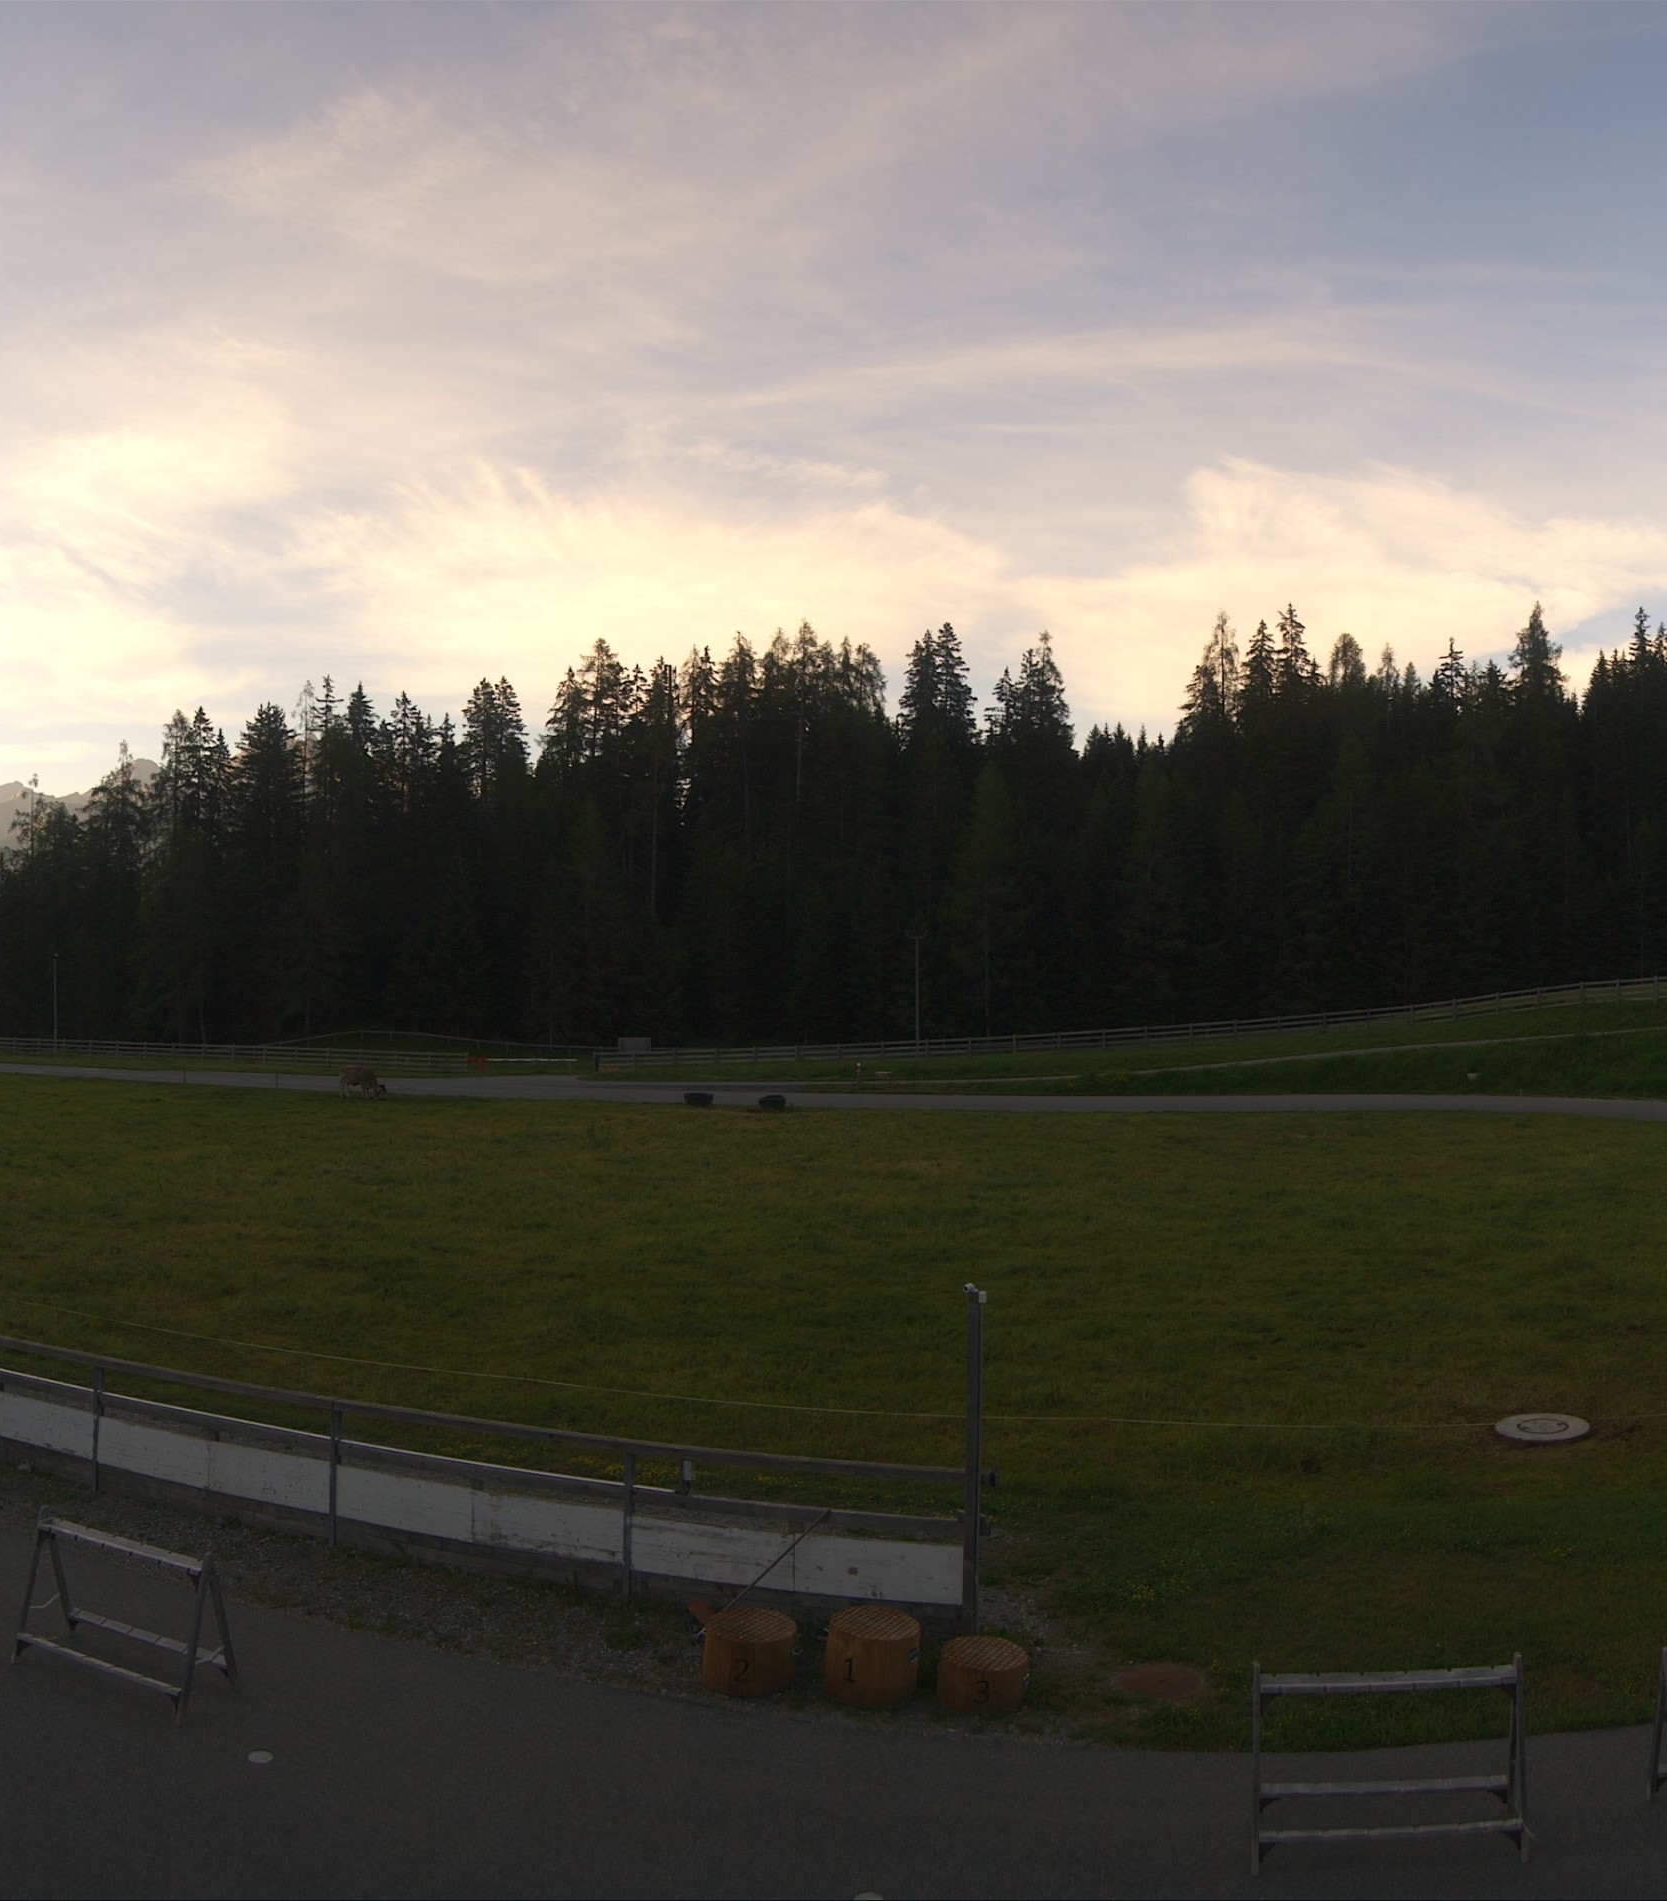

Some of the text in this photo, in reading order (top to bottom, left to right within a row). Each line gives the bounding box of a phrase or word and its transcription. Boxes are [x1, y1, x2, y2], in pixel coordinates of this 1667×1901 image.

[733, 1658, 750, 1683] 2
[843, 1658, 856, 1683] 1
[973, 1679, 991, 1705] 3
